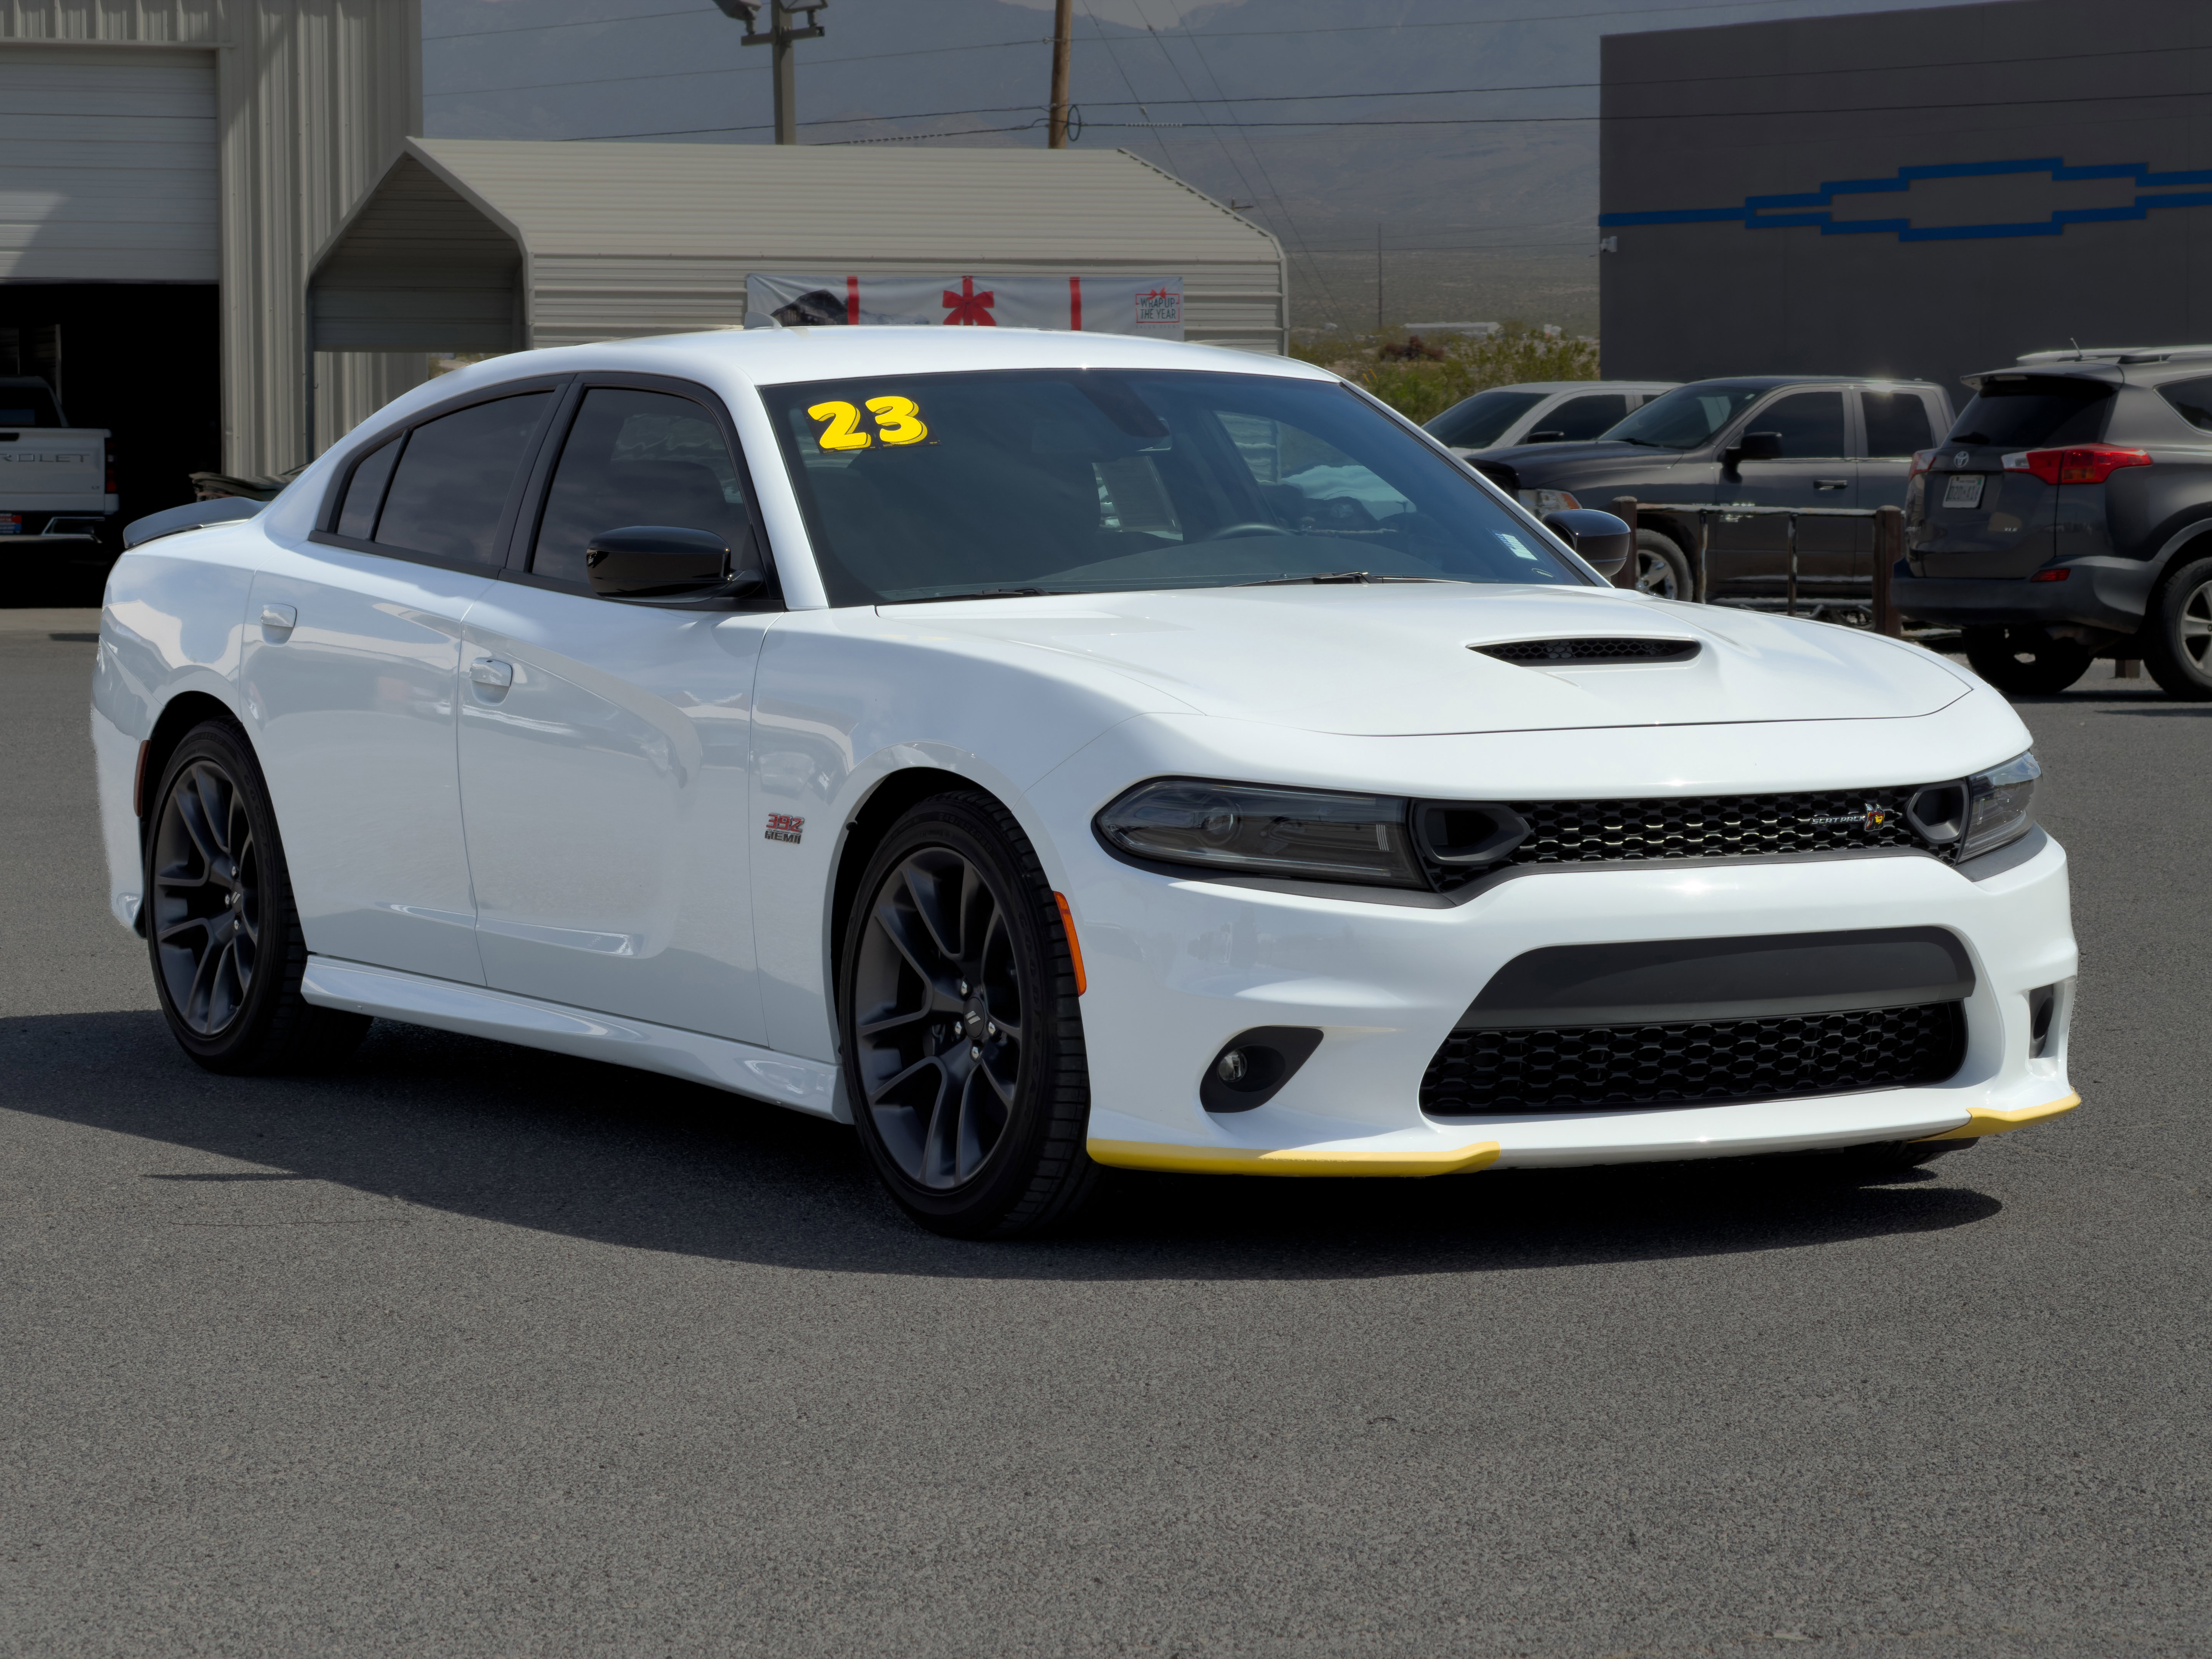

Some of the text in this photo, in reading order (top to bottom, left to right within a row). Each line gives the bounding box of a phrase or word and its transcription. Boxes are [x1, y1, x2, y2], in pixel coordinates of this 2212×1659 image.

[1140, 297, 1175, 308] WRAP UP
[1140, 308, 1176, 320] THE YEAR
[808, 395, 928, 450] 23
[766, 813, 805, 833] 392
[765, 829, 801, 844] HEMI
